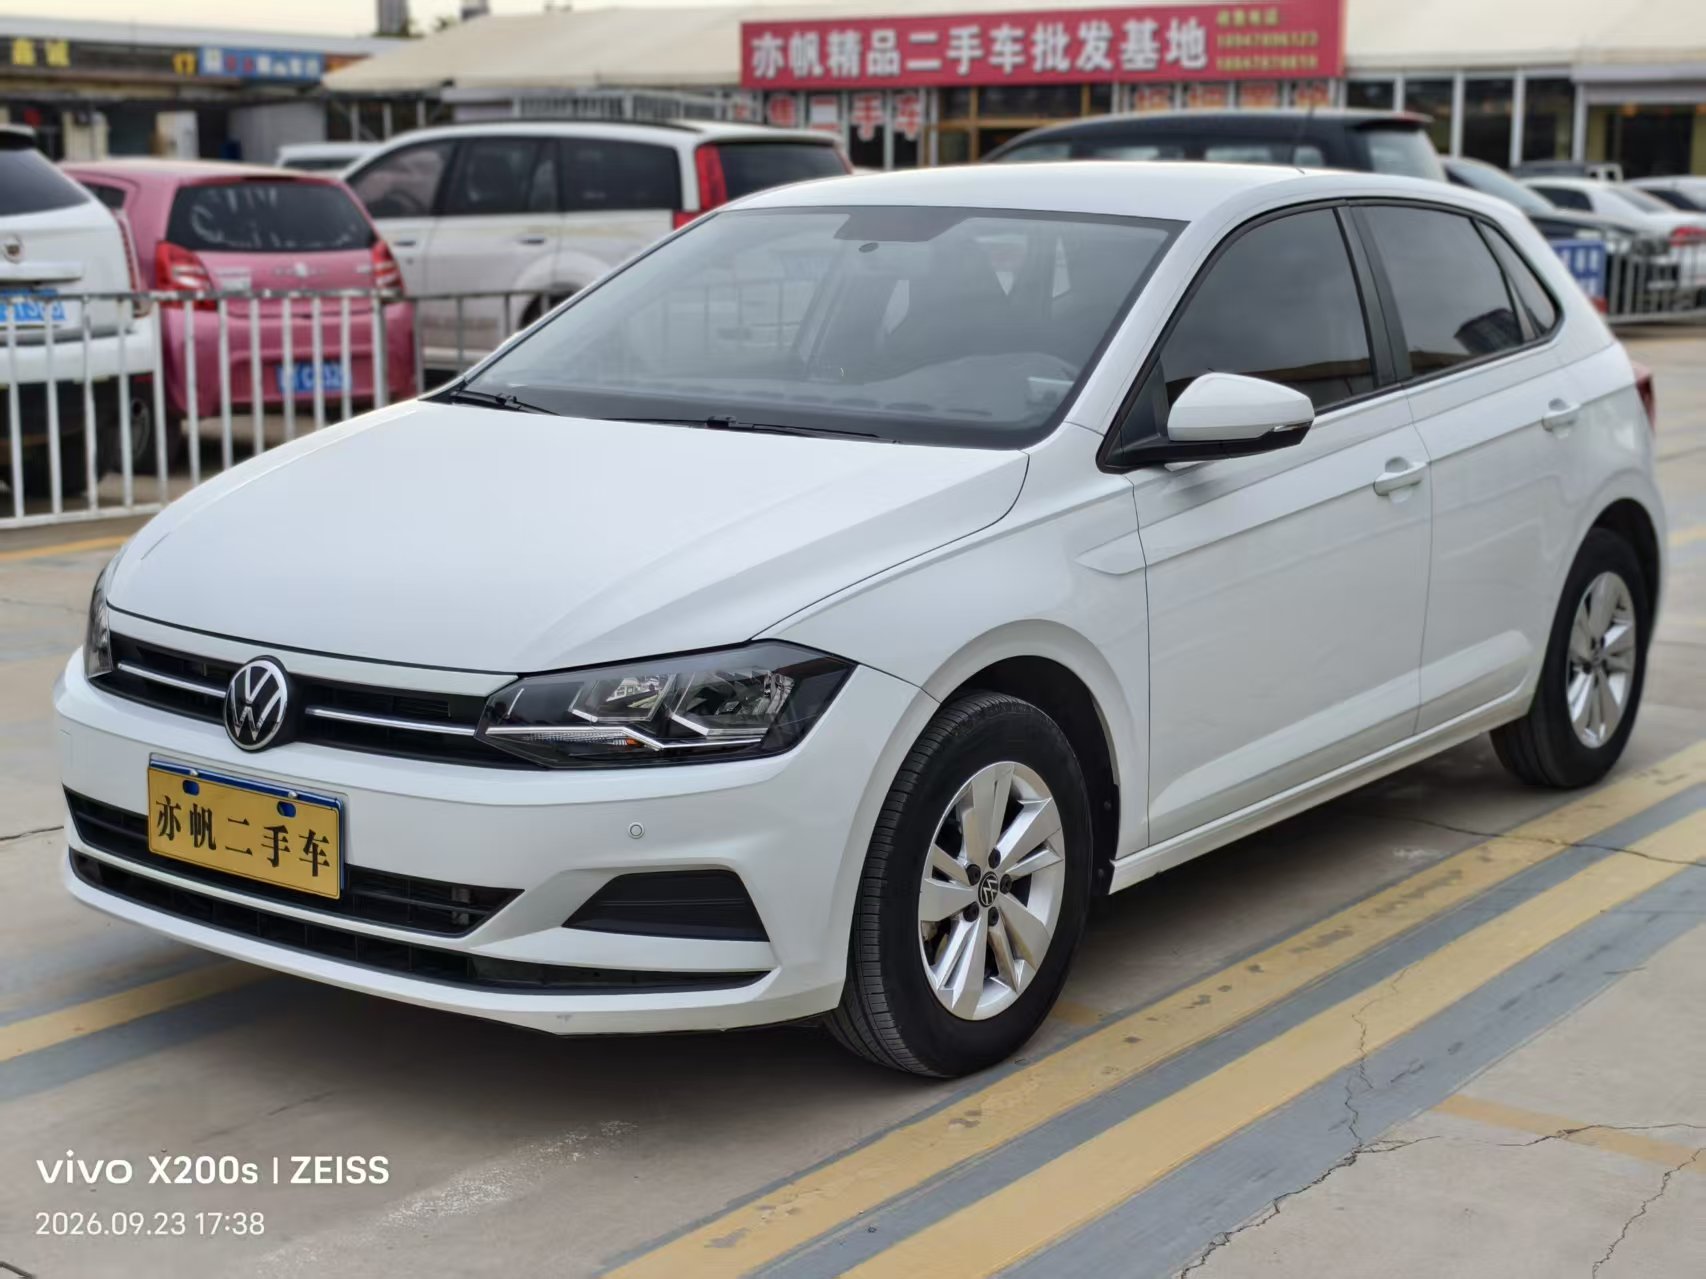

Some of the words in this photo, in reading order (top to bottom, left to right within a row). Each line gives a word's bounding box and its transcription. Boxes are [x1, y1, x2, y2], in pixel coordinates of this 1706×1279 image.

[751, 17, 1208, 79] 亦帆精品二手车批发基地
[155, 795, 331, 878] 亦帆二手车
